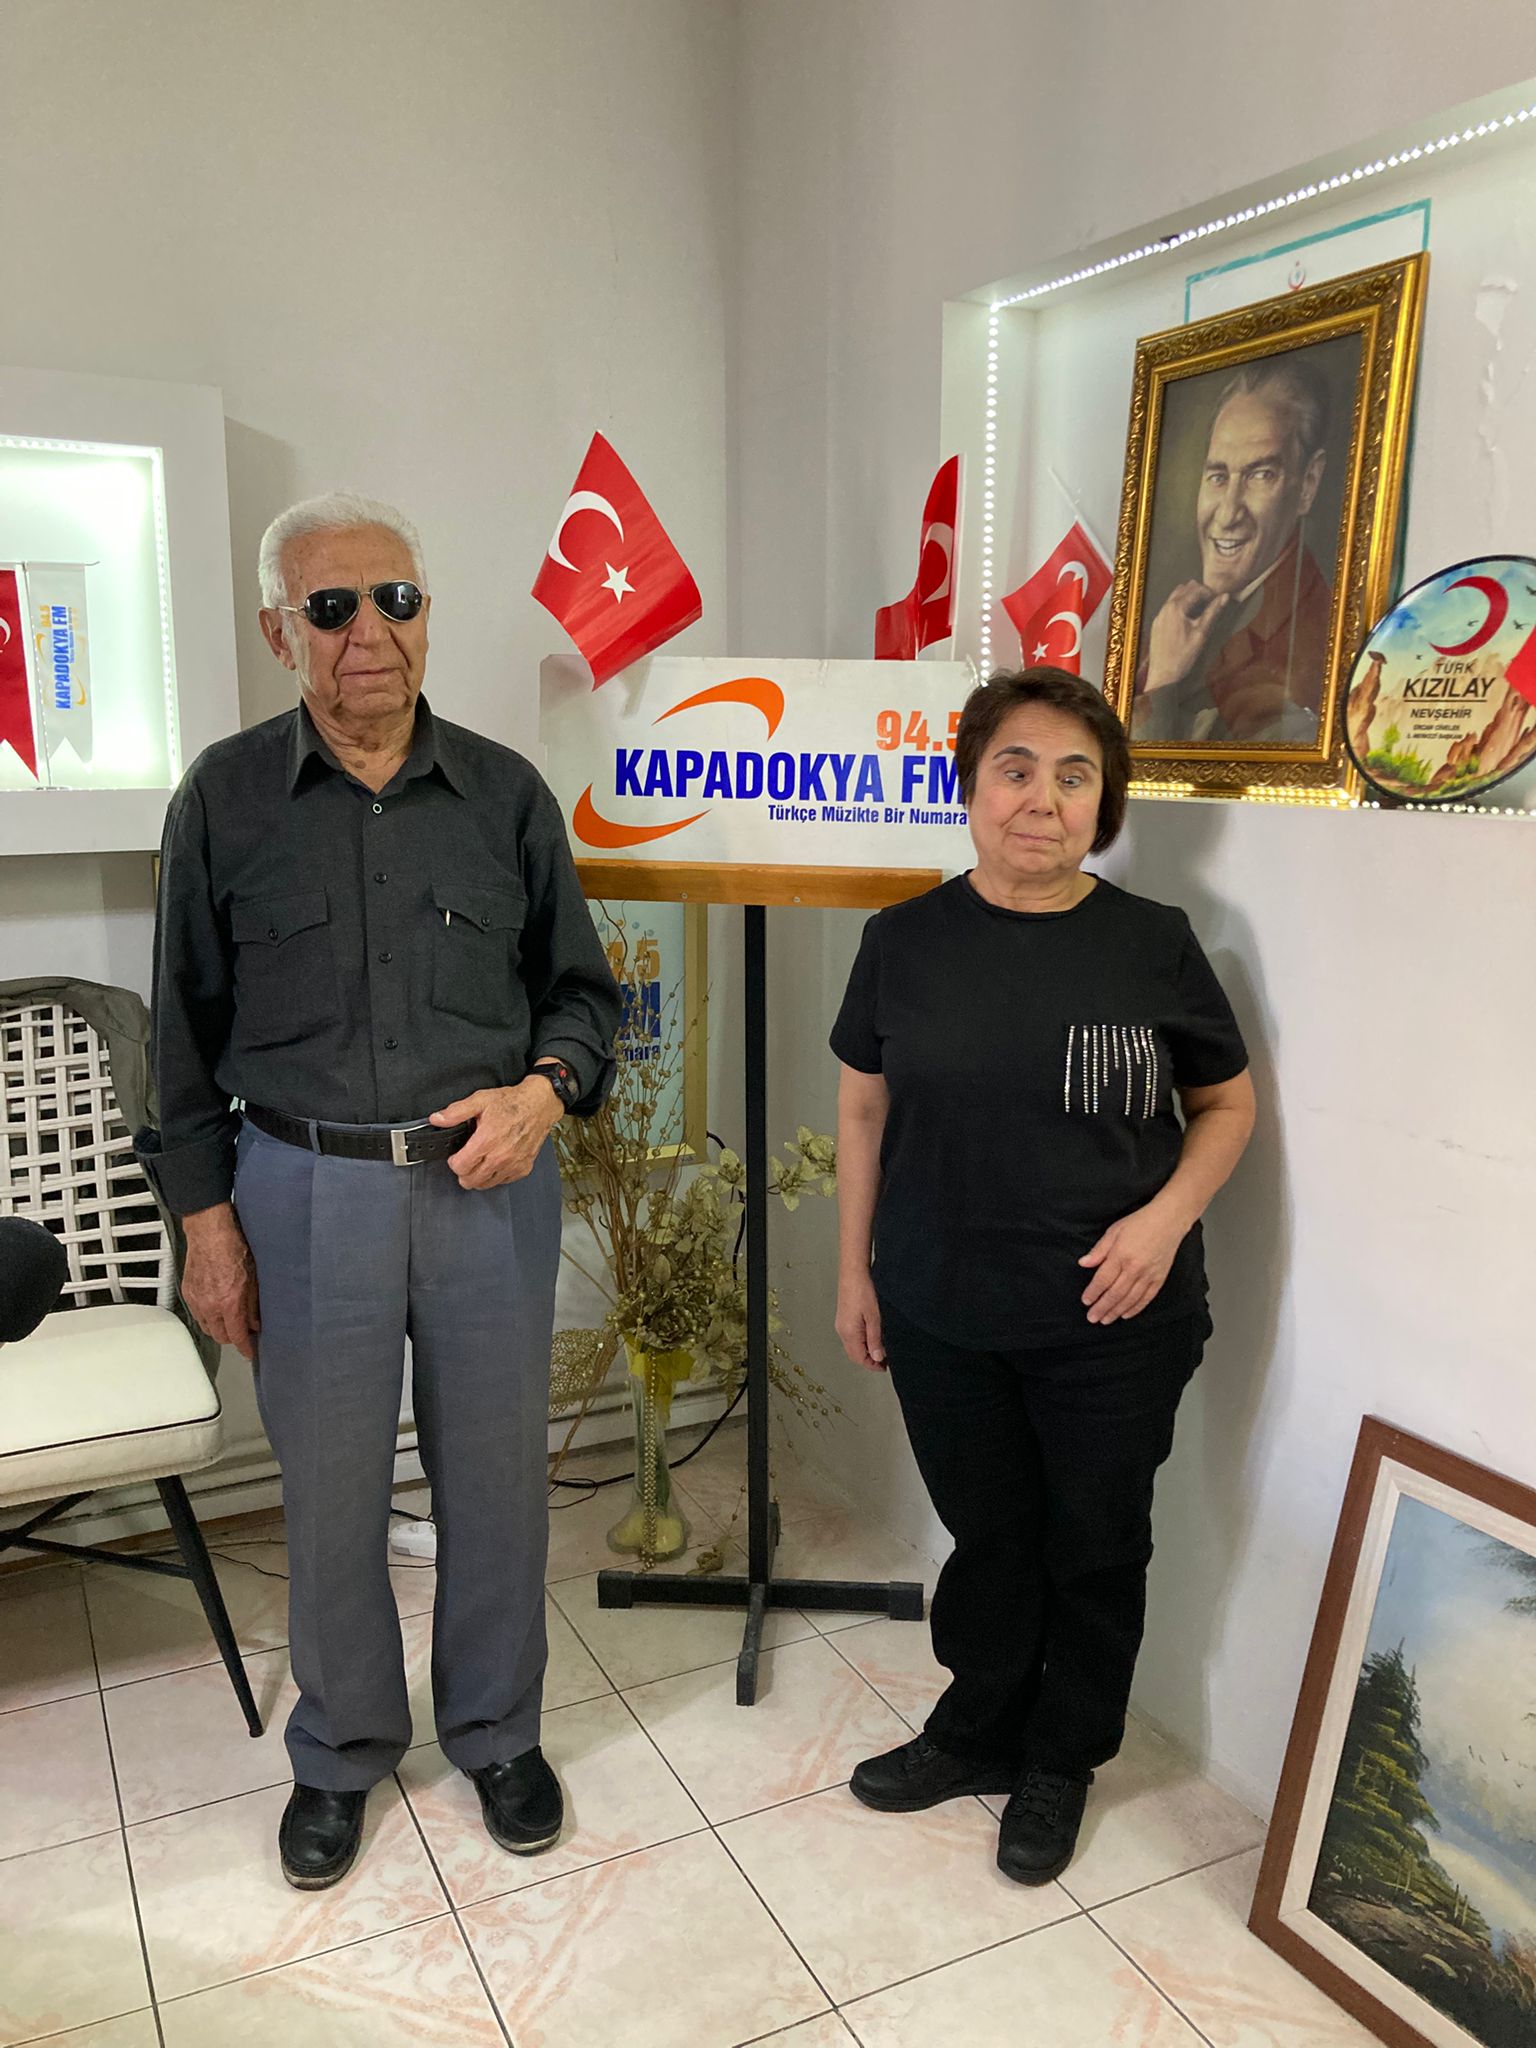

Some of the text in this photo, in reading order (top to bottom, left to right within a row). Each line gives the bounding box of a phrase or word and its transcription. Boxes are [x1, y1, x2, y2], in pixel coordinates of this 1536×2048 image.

[51, 606, 71, 709] KAPADOKYA FM
[1403, 677, 1496, 698] KIZILAY
[1410, 707, 1472, 720] NEVŞEHİR
[615, 748, 966, 804] KAPADOKYA FM
[768, 804, 968, 825] Türkçe Müzikte Bir Numara
